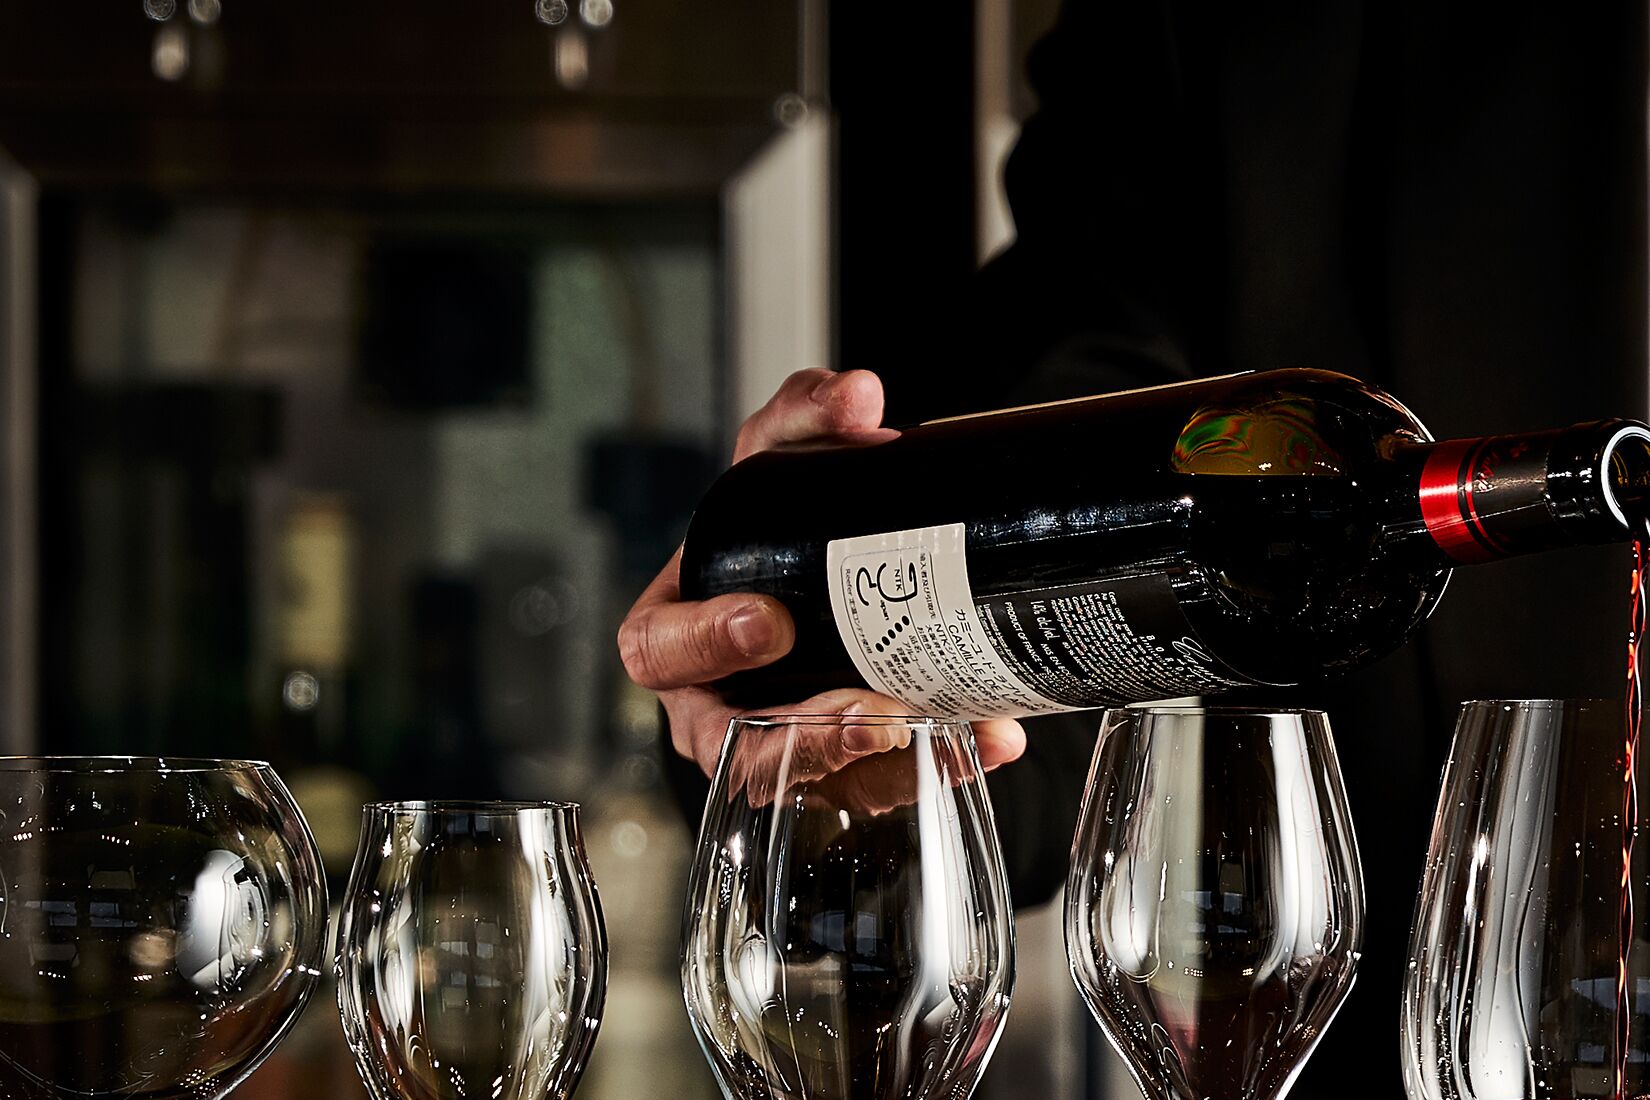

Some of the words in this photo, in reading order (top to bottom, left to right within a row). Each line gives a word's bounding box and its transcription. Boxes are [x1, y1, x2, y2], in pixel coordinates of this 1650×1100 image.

[894, 569, 902, 591] NTK
[1005, 602, 1023, 631] PRODUCT
[1018, 632, 1028, 640] OF
[1023, 641, 1042, 662] FRANCE
[948, 625, 986, 675] CAMILLE
[984, 679, 1003, 691] DE
[1040, 644, 1054, 655] MIS
[1049, 656, 1061, 665] EN
